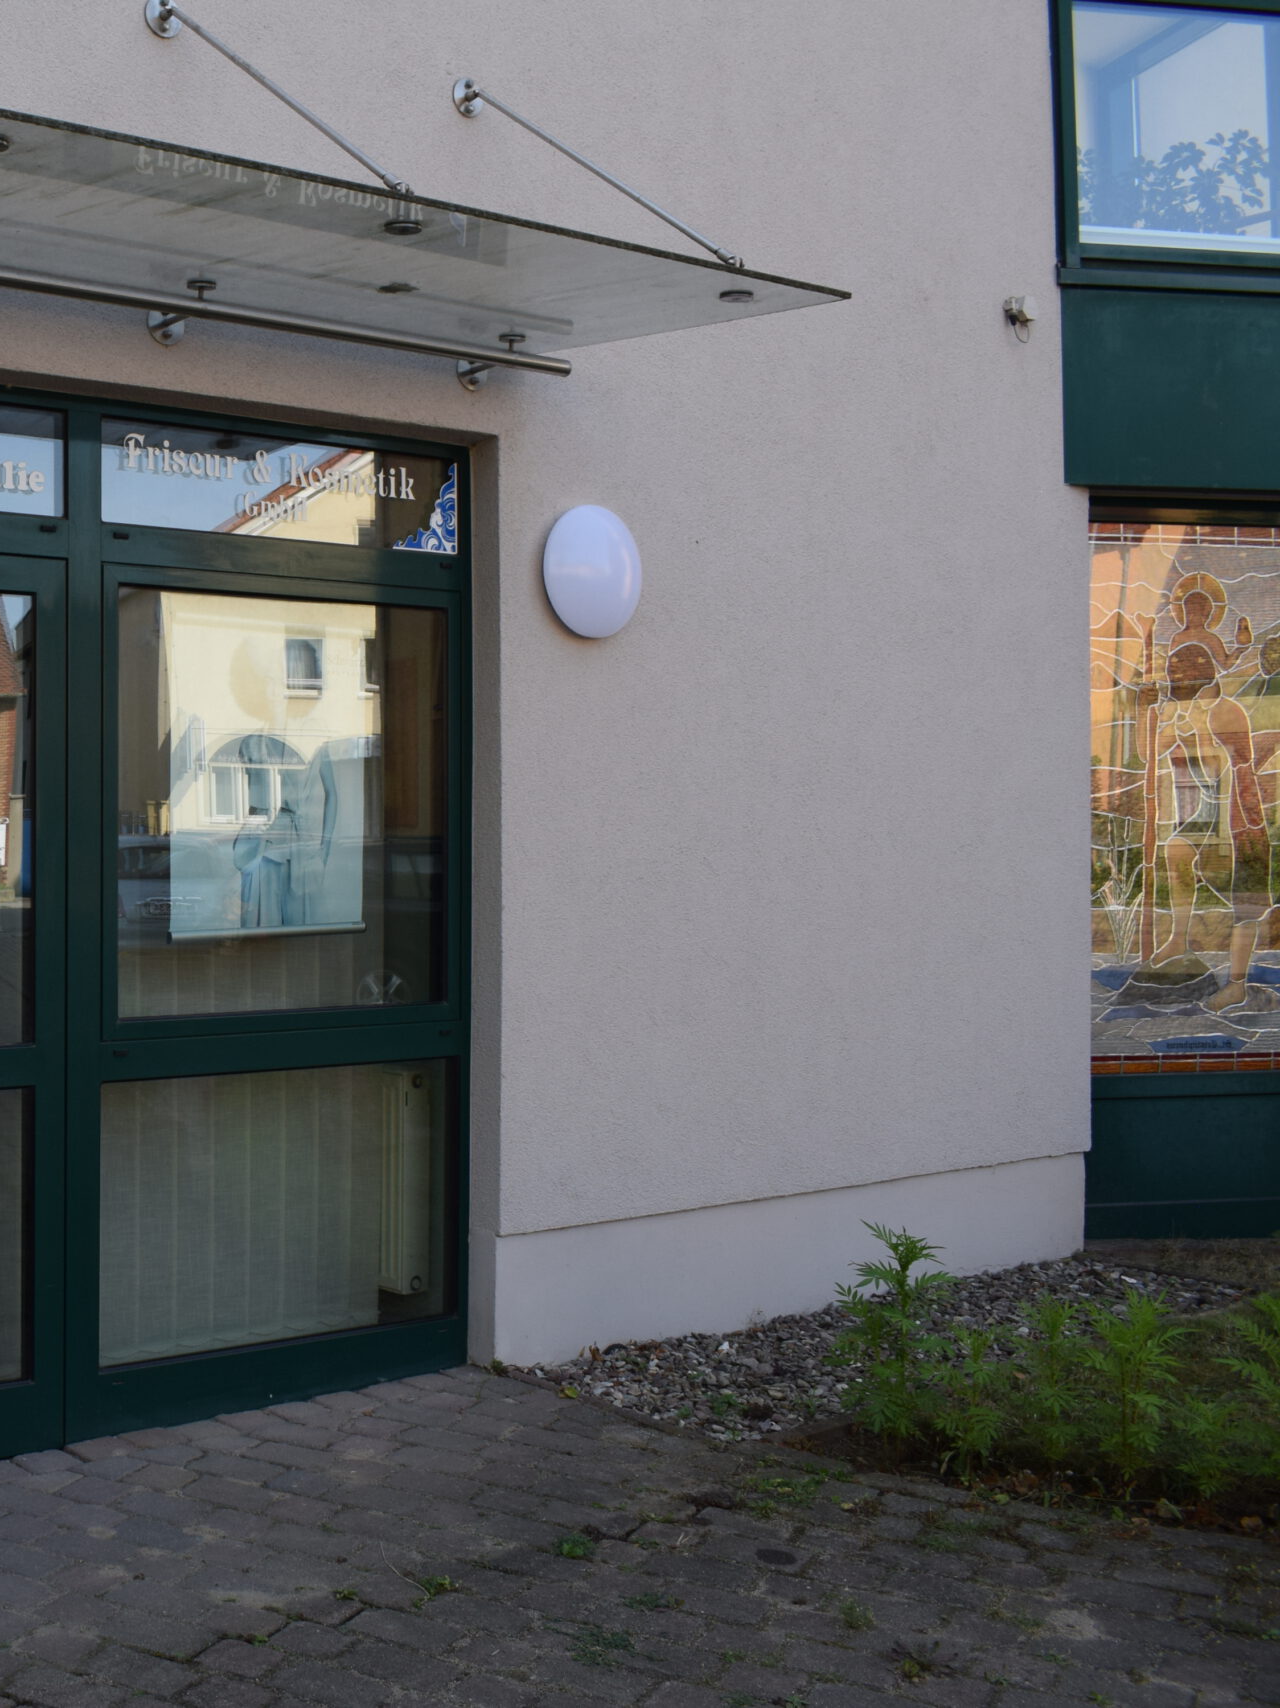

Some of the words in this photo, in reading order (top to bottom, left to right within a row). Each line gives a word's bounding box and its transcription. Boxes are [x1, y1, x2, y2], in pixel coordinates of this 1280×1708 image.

[123, 432, 240, 481] Friseur
[252, 449, 272, 484] &
[287, 452, 417, 501] Kosmetik
